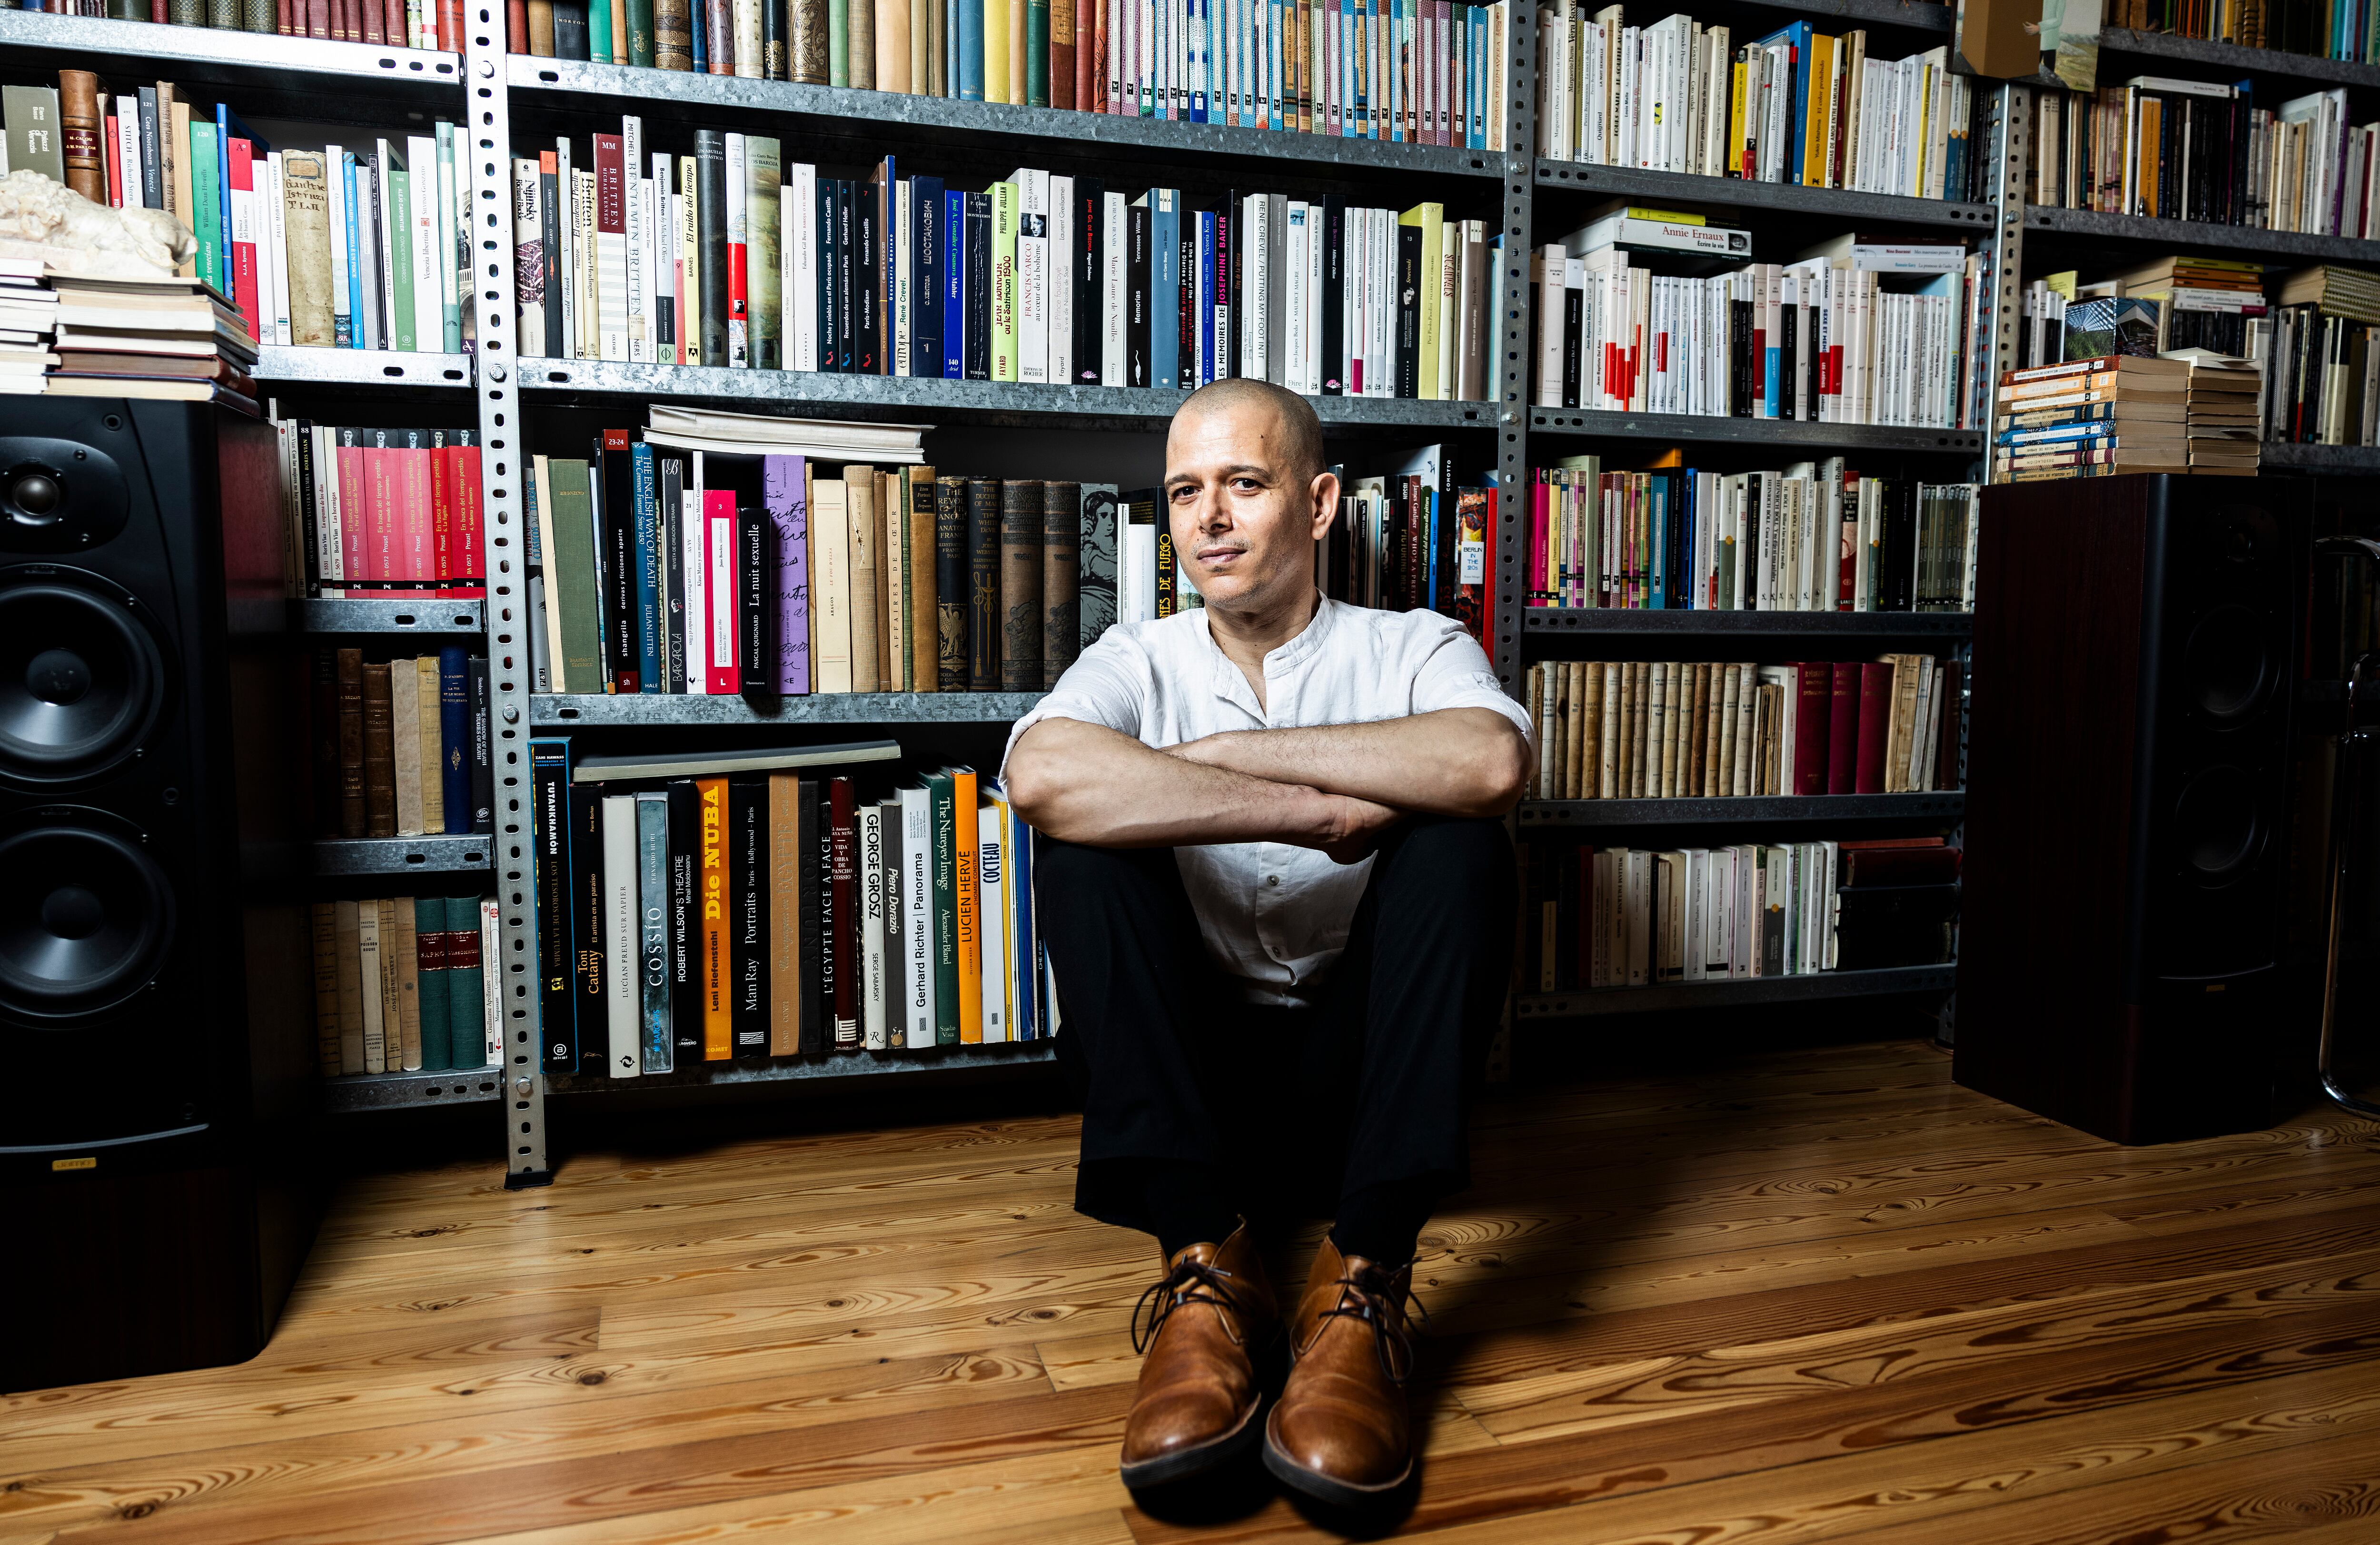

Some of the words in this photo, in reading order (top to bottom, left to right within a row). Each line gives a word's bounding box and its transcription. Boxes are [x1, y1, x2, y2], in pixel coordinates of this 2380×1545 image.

[602, 141, 616, 150] MM
[685, 164, 694, 193] tiempo
[525, 179, 537, 222] Nijinsky
[609, 167, 618, 226] BRITTEN
[685, 210, 694, 232] ruido
[923, 200, 932, 265] ШОСТАКОВИЧ
[1663, 226, 1689, 238] Annie
[1693, 229, 1725, 241] Ernaux
[421, 229, 430, 255] libertina
[686, 234, 694, 243] El
[422, 255, 431, 280] Venezia
[1003, 256, 1011, 278] 1900
[1219, 252, 1227, 305] JOSEPHINE
[1443, 254, 1455, 298] SCANDALS
[1033, 283, 1041, 291] de
[1036, 313, 1041, 322] au
[1219, 307, 1225, 318] DE
[1005, 324, 1011, 335] ou
[897, 331, 910, 368] europe
[433, 458, 441, 478] perdido
[644, 455, 652, 473] THE
[644, 476, 653, 515] ENGLISH
[645, 518, 654, 537] WAY
[645, 539, 654, 553] OF
[748, 524, 759, 565] sexuelle
[647, 555, 655, 587] DEATH
[749, 569, 759, 590] nuit
[892, 557, 897, 571] DE
[749, 593, 759, 607] La
[620, 620, 628, 657] shangrila
[672, 634, 683, 681] BARCAROLA
[547, 782, 559, 854] TUTANKHAMÓN
[939, 797, 951, 818] The
[703, 785, 720, 868] NUBA
[867, 814, 880, 870] GEORGE
[937, 819, 951, 860] Nureyev
[822, 836, 831, 869] FACE
[982, 843, 1000, 883] COCTEAU
[675, 855, 684, 896] THEATRE
[822, 876, 831, 884] A
[888, 868, 898, 894] Piero
[914, 853, 923, 910] Panorama
[936, 861, 949, 891] Image
[705, 875, 721, 920] Die
[823, 891, 832, 923] FACE
[868, 873, 881, 920] GROSZ
[744, 892, 756, 944] Portraits
[889, 895, 900, 934] Dorazio
[961, 897, 972, 942] LUCIEN
[645, 906, 664, 987] COSSÍO
[914, 920, 924, 959] Richter
[577, 950, 588, 973] Toni
[588, 950, 604, 994] Catany
[677, 944, 686, 982] ROBERT
[710, 931, 719, 988] Riefenstahl
[745, 958, 759, 981] Ray
[485, 980, 493, 1007] Apollinaire
[711, 991, 719, 1011] Leni
[745, 983, 757, 1010] Man
[915, 962, 926, 1008] Gerhard
[486, 1007, 494, 1033] Guillaume
